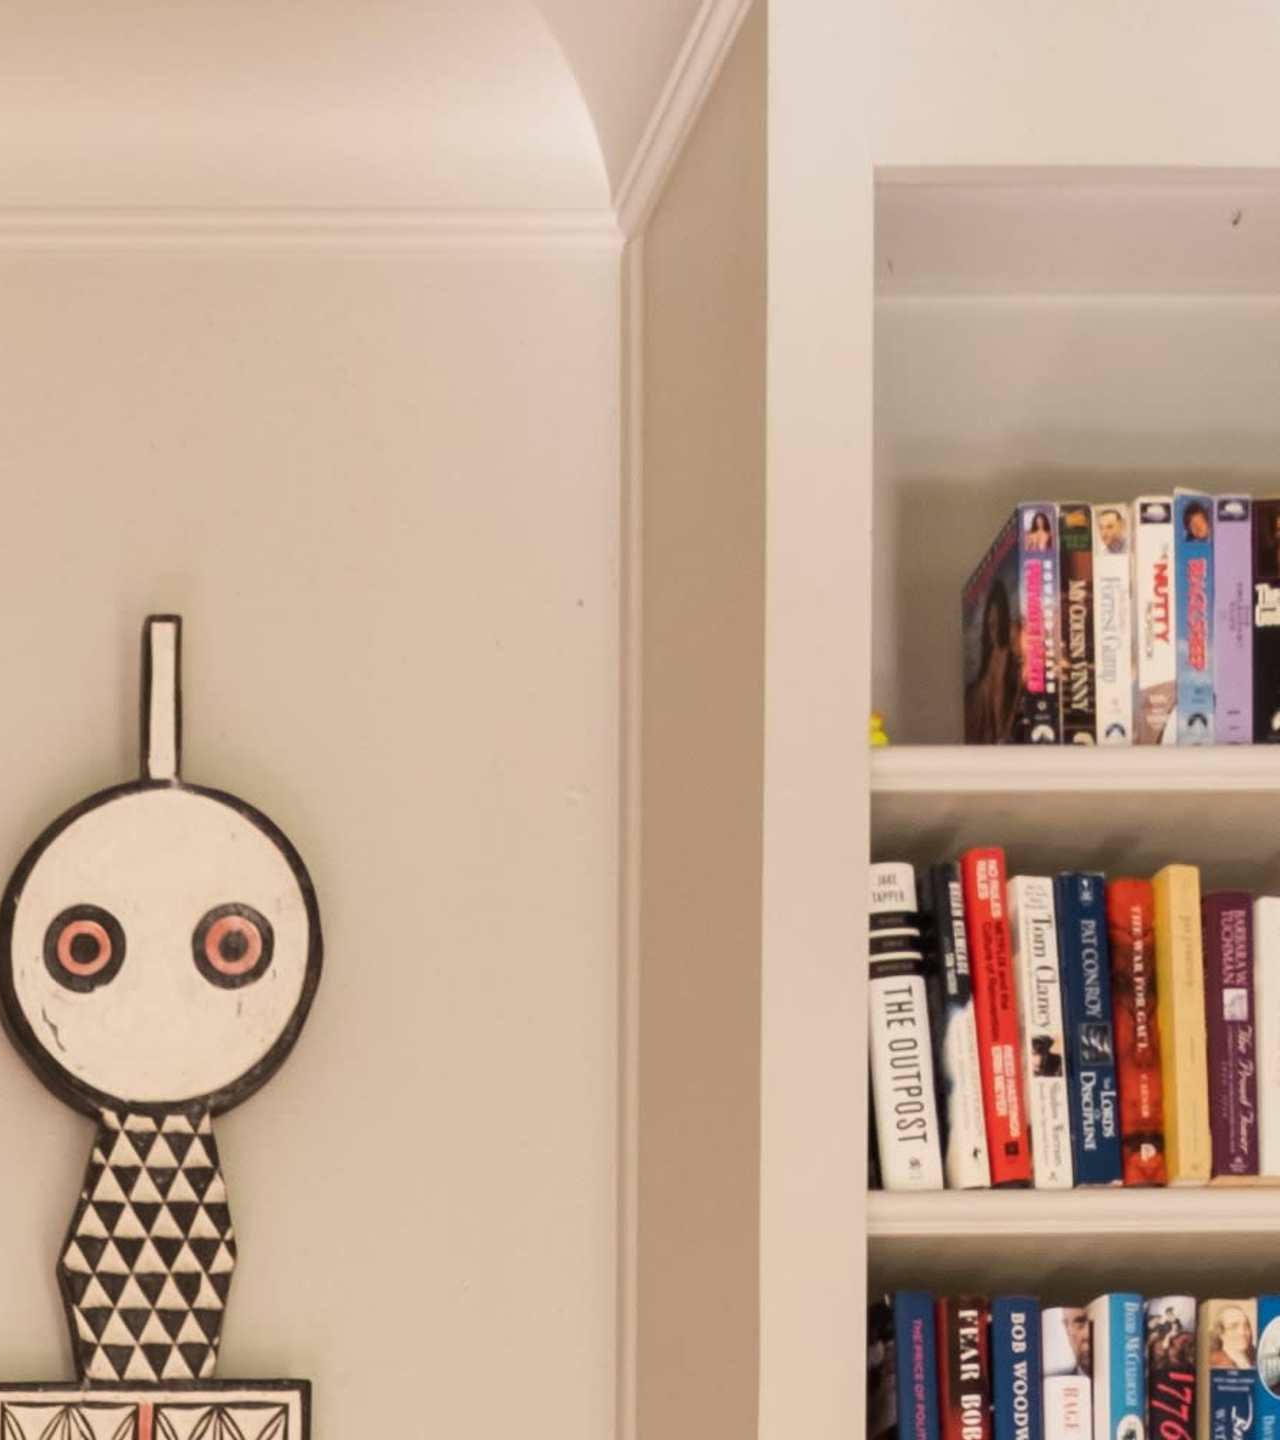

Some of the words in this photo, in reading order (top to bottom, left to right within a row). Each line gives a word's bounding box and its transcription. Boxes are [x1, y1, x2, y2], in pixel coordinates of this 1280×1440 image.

[1043, 560, 1053, 630] HOWARD
[1099, 577, 1120, 632] Forrest
[1153, 563, 1170, 644] NUTTY
[1069, 603, 1088, 659] COUSIN
[1100, 636, 1122, 683] Gump
[1031, 914, 1053, 958] Tom
[1080, 919, 1096, 944] PAT
[1130, 905, 1144, 936] THE
[1234, 910, 1247, 971] BARBARA
[1131, 939, 1145, 973] WAR
[1221, 910, 1235, 985] TUCHMAN
[1035, 965, 1057, 1030] Clancy
[1081, 945, 1102, 1019] CONROY
[1132, 977, 1146, 1008] FOR
[884, 985, 917, 1029] THE
[1133, 1011, 1148, 1053] GAUL
[1237, 1023, 1253, 1055] The
[889, 1040, 928, 1144] OUTPOST
[1237, 1060, 1254, 1107] Proud
[1078, 1071, 1097, 1152] DISCIPLINE
[1100, 1090, 1116, 1139] LORDS
[958, 1309, 979, 1381] FEAR
[1011, 1312, 1028, 1354] BOB
[913, 1341, 924, 1380] PRICE
[915, 1383, 925, 1401] OF
[1063, 1386, 1079, 1432] RAGE
